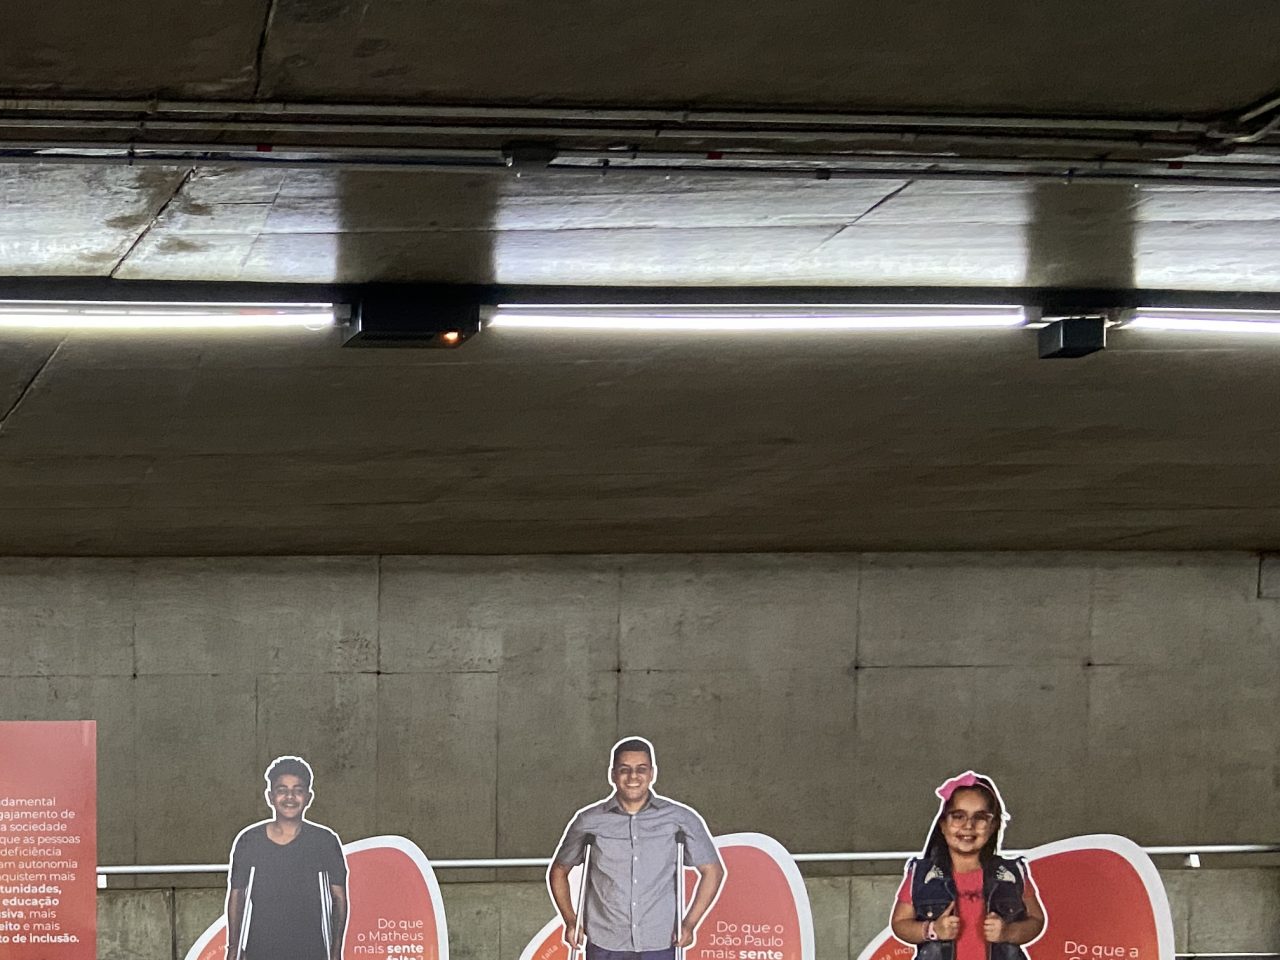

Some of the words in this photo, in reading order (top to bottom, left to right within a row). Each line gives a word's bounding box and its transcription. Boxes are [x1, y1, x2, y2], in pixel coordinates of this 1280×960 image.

[60, 809, 76, 819] de
[0, 824, 6, 832] a
[10, 822, 68, 832] sociedade
[23, 836, 35, 844] as
[38, 836, 80, 846] pessoas
[0, 847, 62, 856] deficiência
[18, 859, 78, 869] autonomia
[50, 872, 76, 881] mais
[2, 896, 60, 908] educação
[30, 909, 56, 918] mais
[32, 921, 60, 930] mais
[378, 918, 396, 928] Do
[399, 920, 424, 930] que
[716, 921, 738, 933] Do
[742, 923, 771, 936] que
[774, 924, 784, 933] o
[12, 934, 26, 944] de
[30, 933, 80, 944] inclusão.
[358, 934, 366, 942] o
[370, 930, 424, 942] Matheus
[709, 934, 742, 946] João
[744, 935, 784, 946] Paulo
[354, 944, 384, 954] mais
[386, 944, 424, 954] sente
[700, 948, 736, 958] mais
[740, 950, 784, 960] sente
[1064, 941, 1088, 954] Do
[1092, 944, 1125, 958] que
[1130, 947, 1139, 958] a
